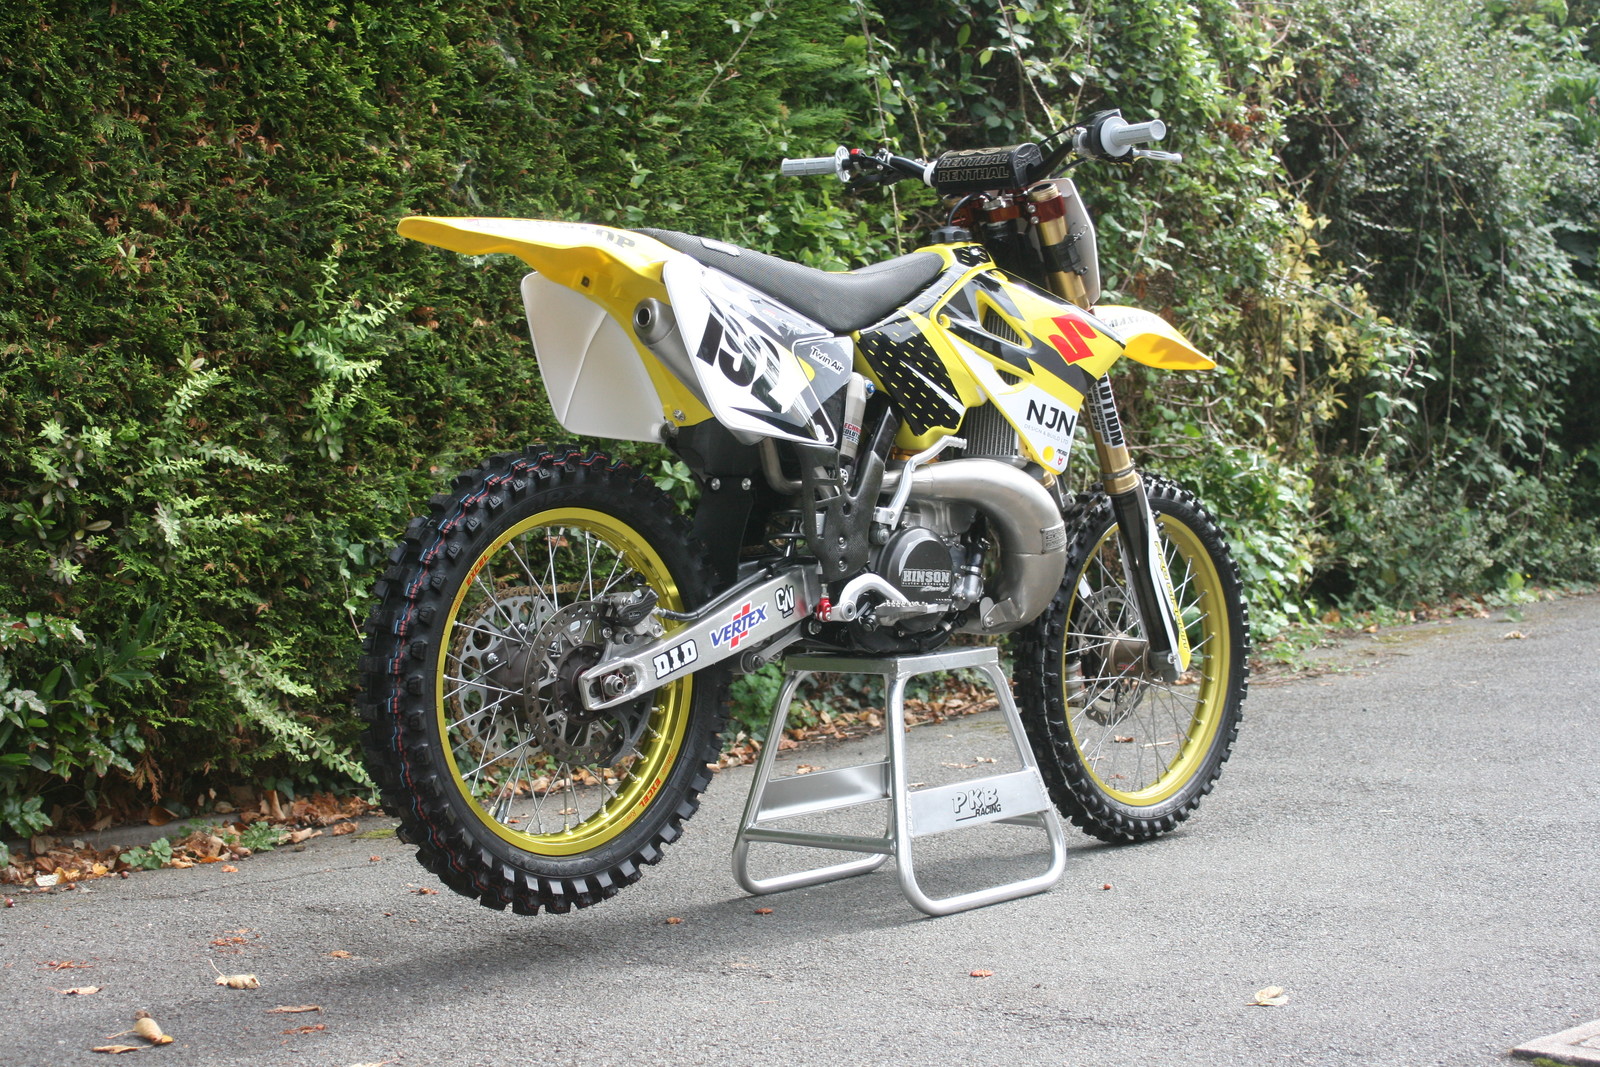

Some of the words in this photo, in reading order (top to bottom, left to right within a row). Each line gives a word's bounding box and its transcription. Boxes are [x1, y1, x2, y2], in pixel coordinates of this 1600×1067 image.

[937, 153, 1009, 169] RENTHAL
[938, 166, 1010, 183] RENTHAL
[811, 346, 831, 365] Twin
[831, 361, 844, 372] Air
[1026, 399, 1076, 437] NJN
[1097, 372, 1124, 447] LUTION
[902, 570, 950, 583] HINSON
[710, 604, 767, 647] VERTEX
[952, 786, 1000, 814] PKB
[975, 803, 1002, 817] RACING
